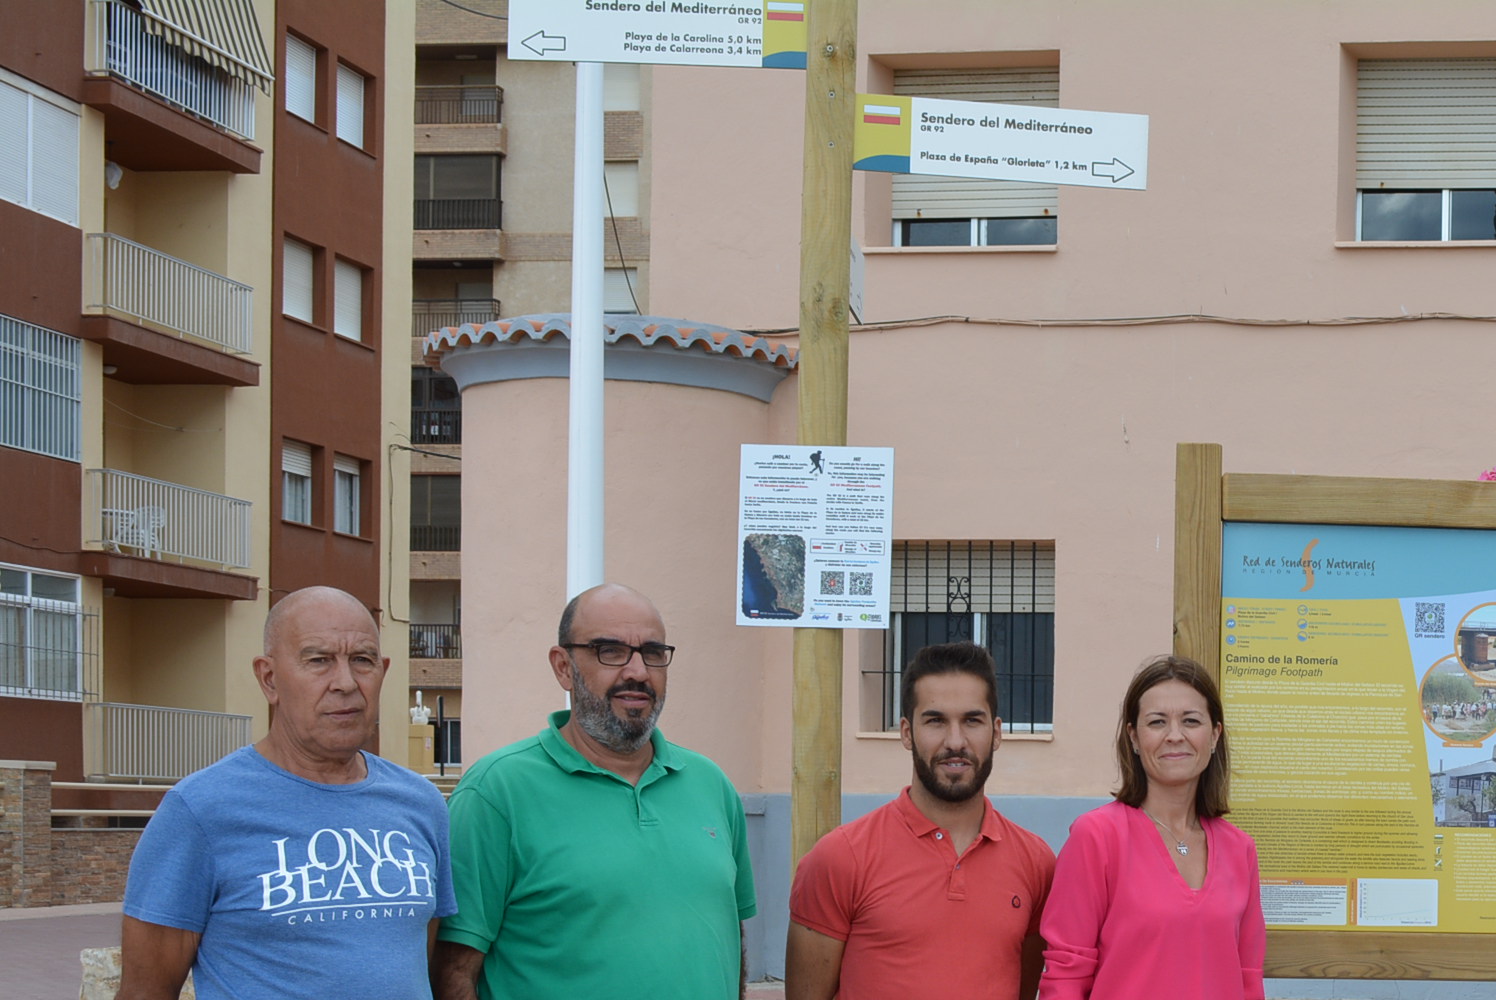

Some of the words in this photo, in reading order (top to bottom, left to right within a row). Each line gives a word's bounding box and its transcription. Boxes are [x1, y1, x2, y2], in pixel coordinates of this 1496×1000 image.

[585, 0, 640, 12] Sendero
[645, 1, 666, 13] del
[670, 2, 762, 16] Mediterráneo
[737, 17, 749, 25] GR
[750, 17, 762, 25] 92
[625, 32, 653, 43] Playa
[656, 32, 668, 42] de
[671, 33, 681, 42] la
[683, 33, 724, 44] Carolina
[727, 35, 744, 45] 5,0
[746, 35, 762, 45] km
[623, 43, 652, 54] Playa
[655, 43, 667, 53] de
[669, 44, 724, 55] Calarreona
[727, 46, 743, 56] 3,4
[746, 46, 762, 56] km
[920, 112, 976, 126] Sendero
[979, 116, 1000, 129] del
[1003, 118, 1093, 135] Mediterráneo
[920, 125, 932, 133] GR
[933, 125, 945, 133] 92
[920, 151, 947, 162] Plaza
[949, 153, 962, 163] de
[964, 154, 999, 166] España
[1054, 160, 1070, 171] 1,2
[1072, 161, 1088, 171] km
[1243, 555, 1261, 567] Red
[1265, 557, 1276, 567] de
[1281, 556, 1322, 570] Senderos
[1326, 558, 1376, 571] Naturales
[1225, 654, 1265, 664] Camino
[1268, 654, 1281, 664] de
[1283, 655, 1293, 665] la
[1295, 655, 1339, 666] Romería
[1225, 666, 1278, 679] Pilgrimage
[1280, 667, 1323, 680] Footpath
[272, 828, 418, 878] LONG
[256, 857, 434, 911] BEACH
[287, 907, 416, 925] CALIFORNIA
